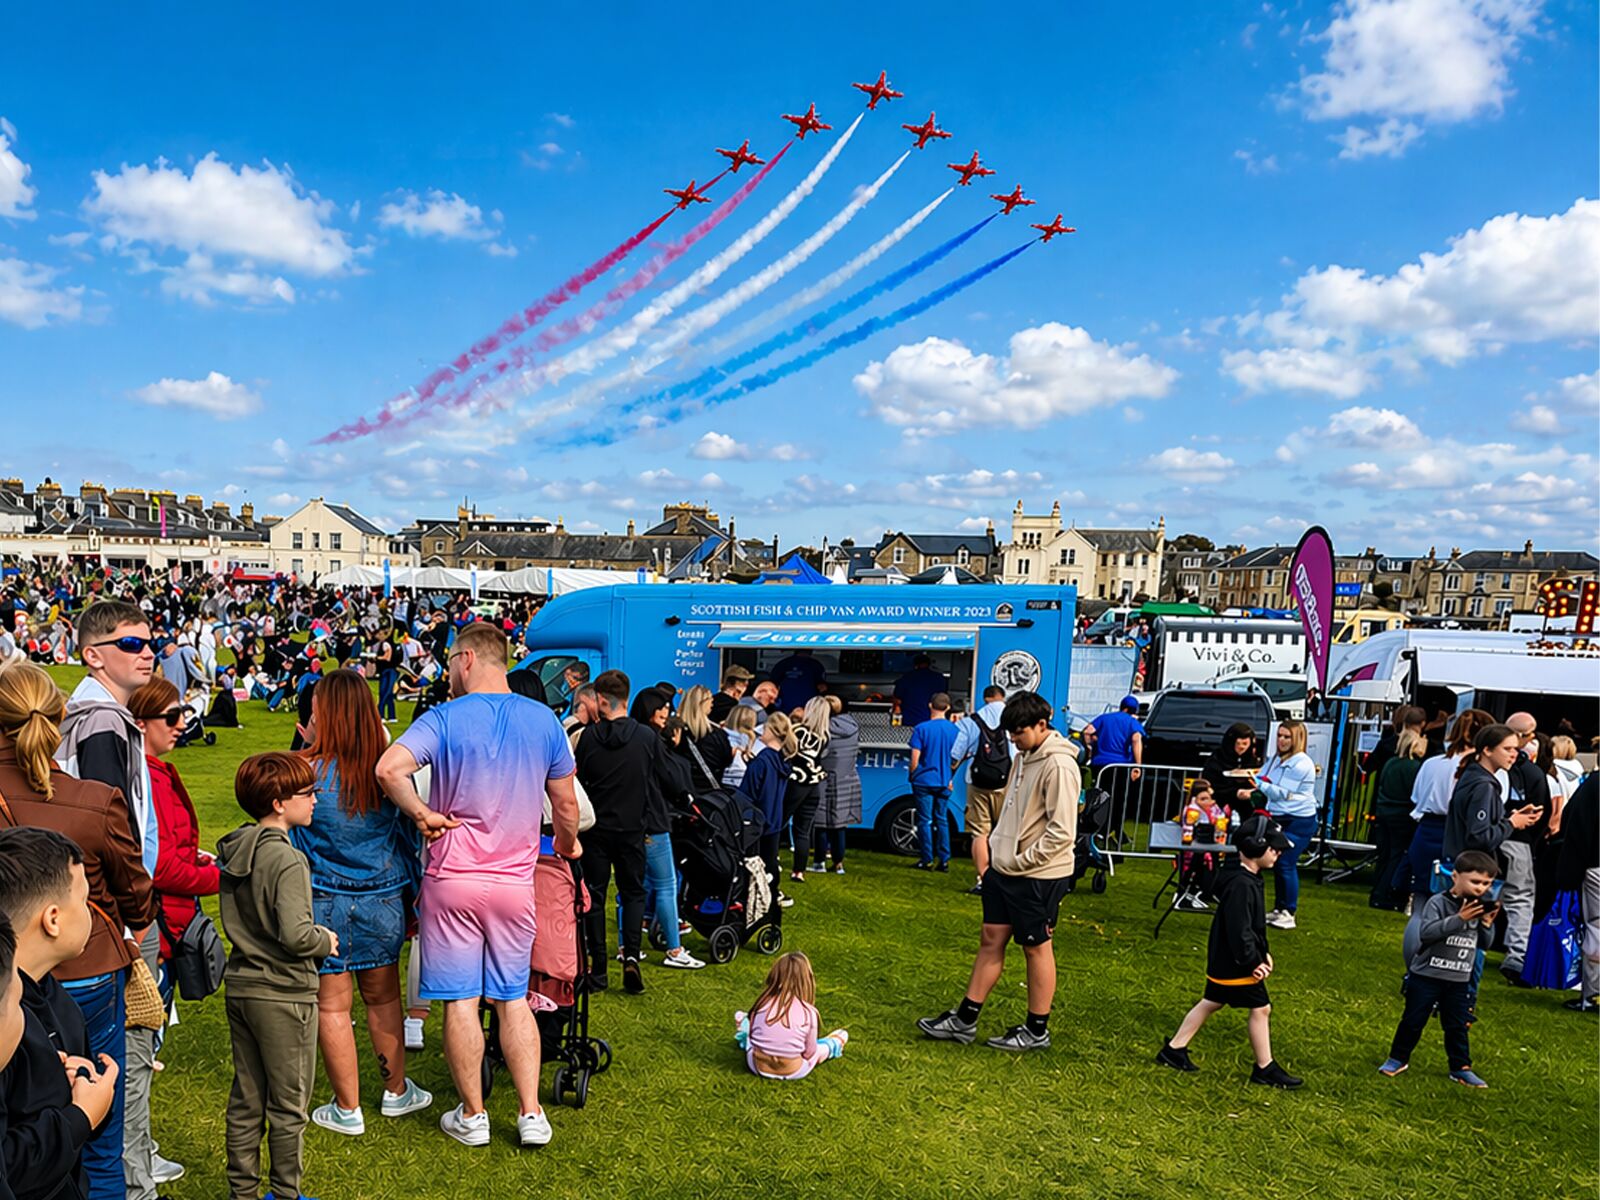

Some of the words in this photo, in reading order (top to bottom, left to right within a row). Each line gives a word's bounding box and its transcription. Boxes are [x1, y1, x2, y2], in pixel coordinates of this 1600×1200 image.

[690, 604, 750, 616] SCOTTISH
[753, 604, 781, 616] FISH
[784, 605, 793, 616] &
[796, 605, 827, 616] CHIP
[858, 605, 905, 616] AWARD
[908, 606, 961, 617] WINNER
[963, 606, 992, 617] 2023
[1192, 647, 1228, 662] Vivi
[1231, 648, 1245, 662] &
[1248, 648, 1276, 663] Co.
